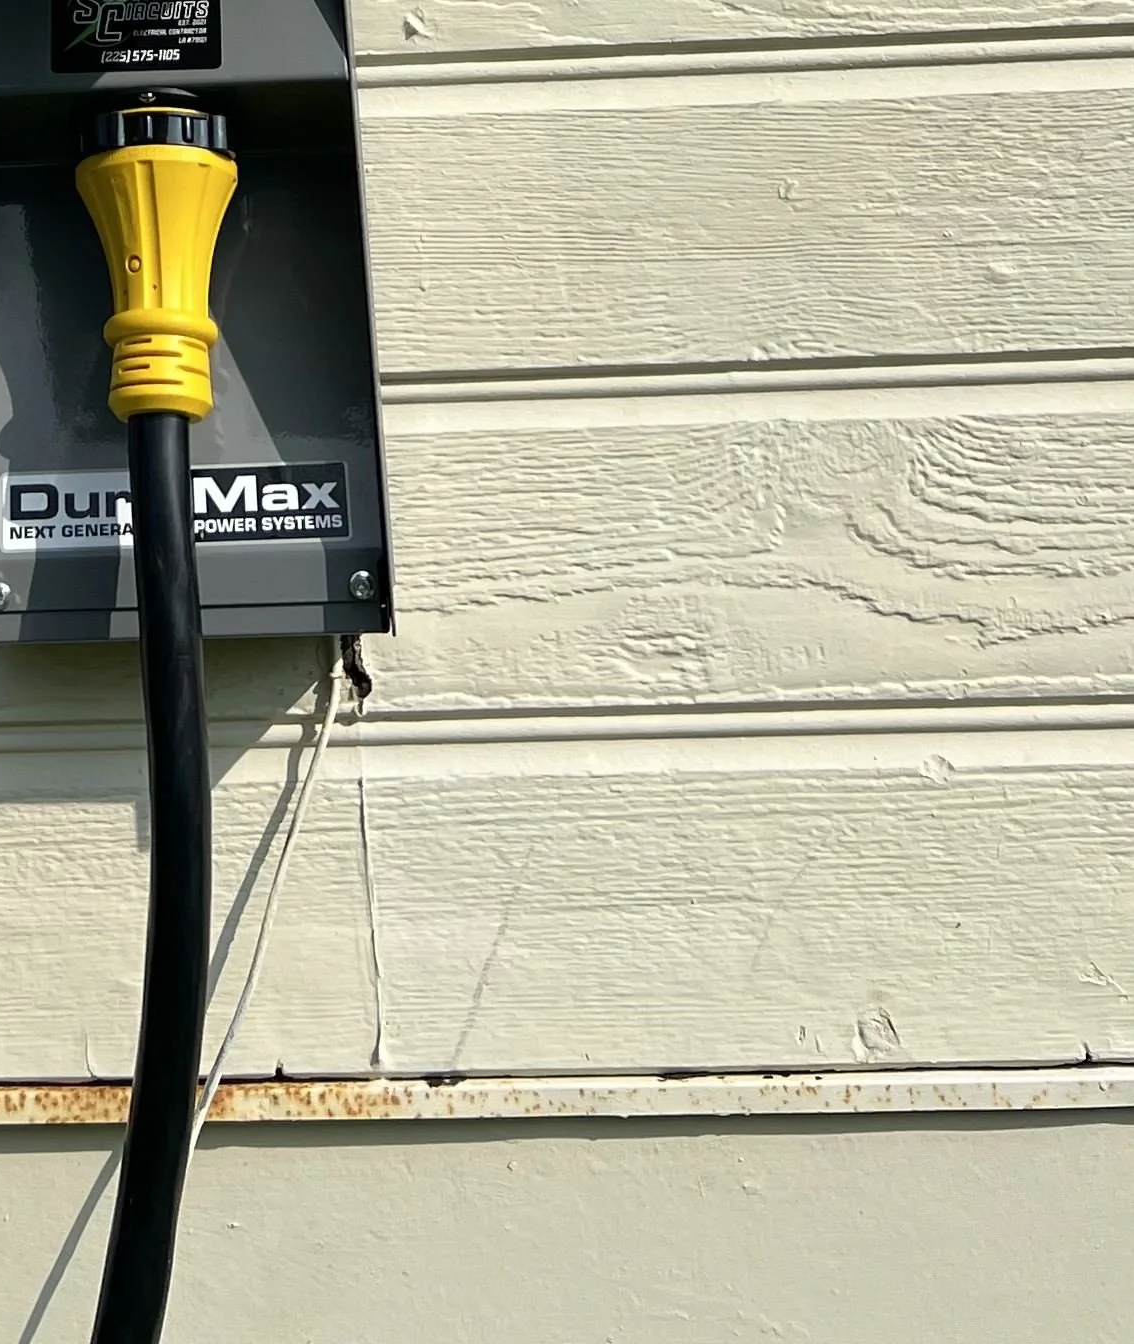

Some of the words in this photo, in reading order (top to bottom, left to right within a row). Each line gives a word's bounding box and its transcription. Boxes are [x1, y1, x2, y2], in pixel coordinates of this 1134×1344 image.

[95, 0, 210, 42] CIRCUITS
[9, 483, 132, 521] Dur
[193, 474, 341, 514] Max
[9, 524, 56, 541] NEXT
[61, 522, 134, 538] GENERA
[194, 516, 257, 534] POWER
[261, 514, 344, 532] SYSTEMS
